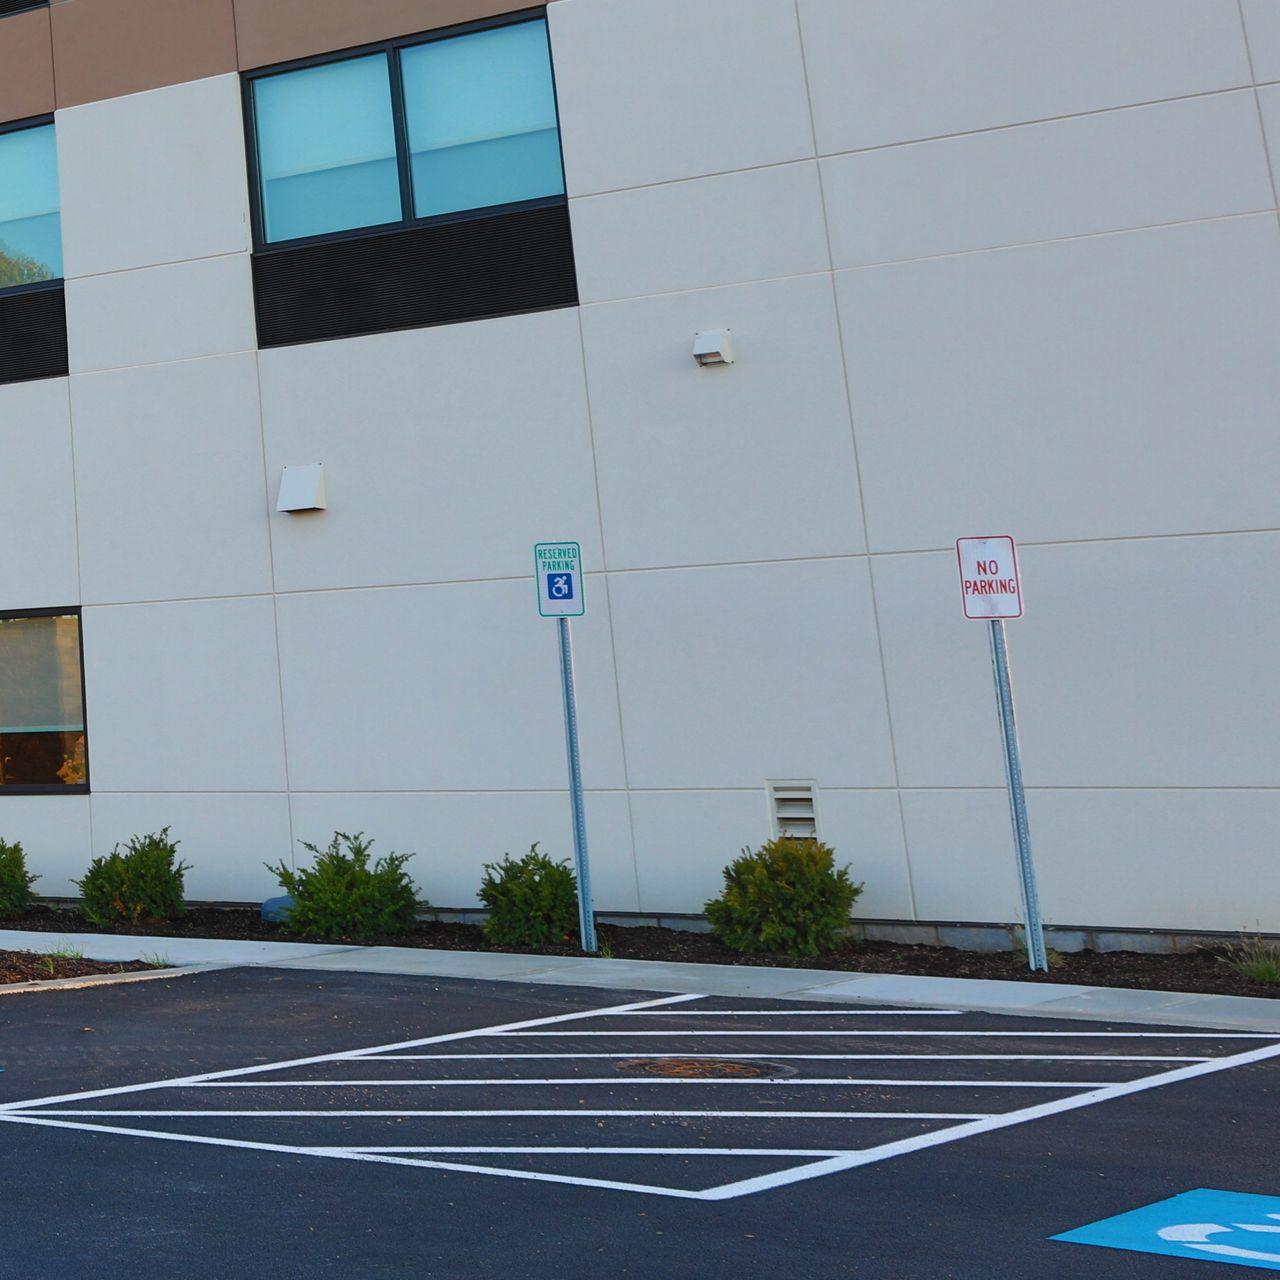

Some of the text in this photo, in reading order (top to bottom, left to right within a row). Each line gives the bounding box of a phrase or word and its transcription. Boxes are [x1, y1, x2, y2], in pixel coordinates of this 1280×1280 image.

[538, 548, 577, 559] RESERVED
[542, 560, 575, 571] PARKING
[976, 559, 998, 575] NO
[964, 578, 1016, 595] PARKING
